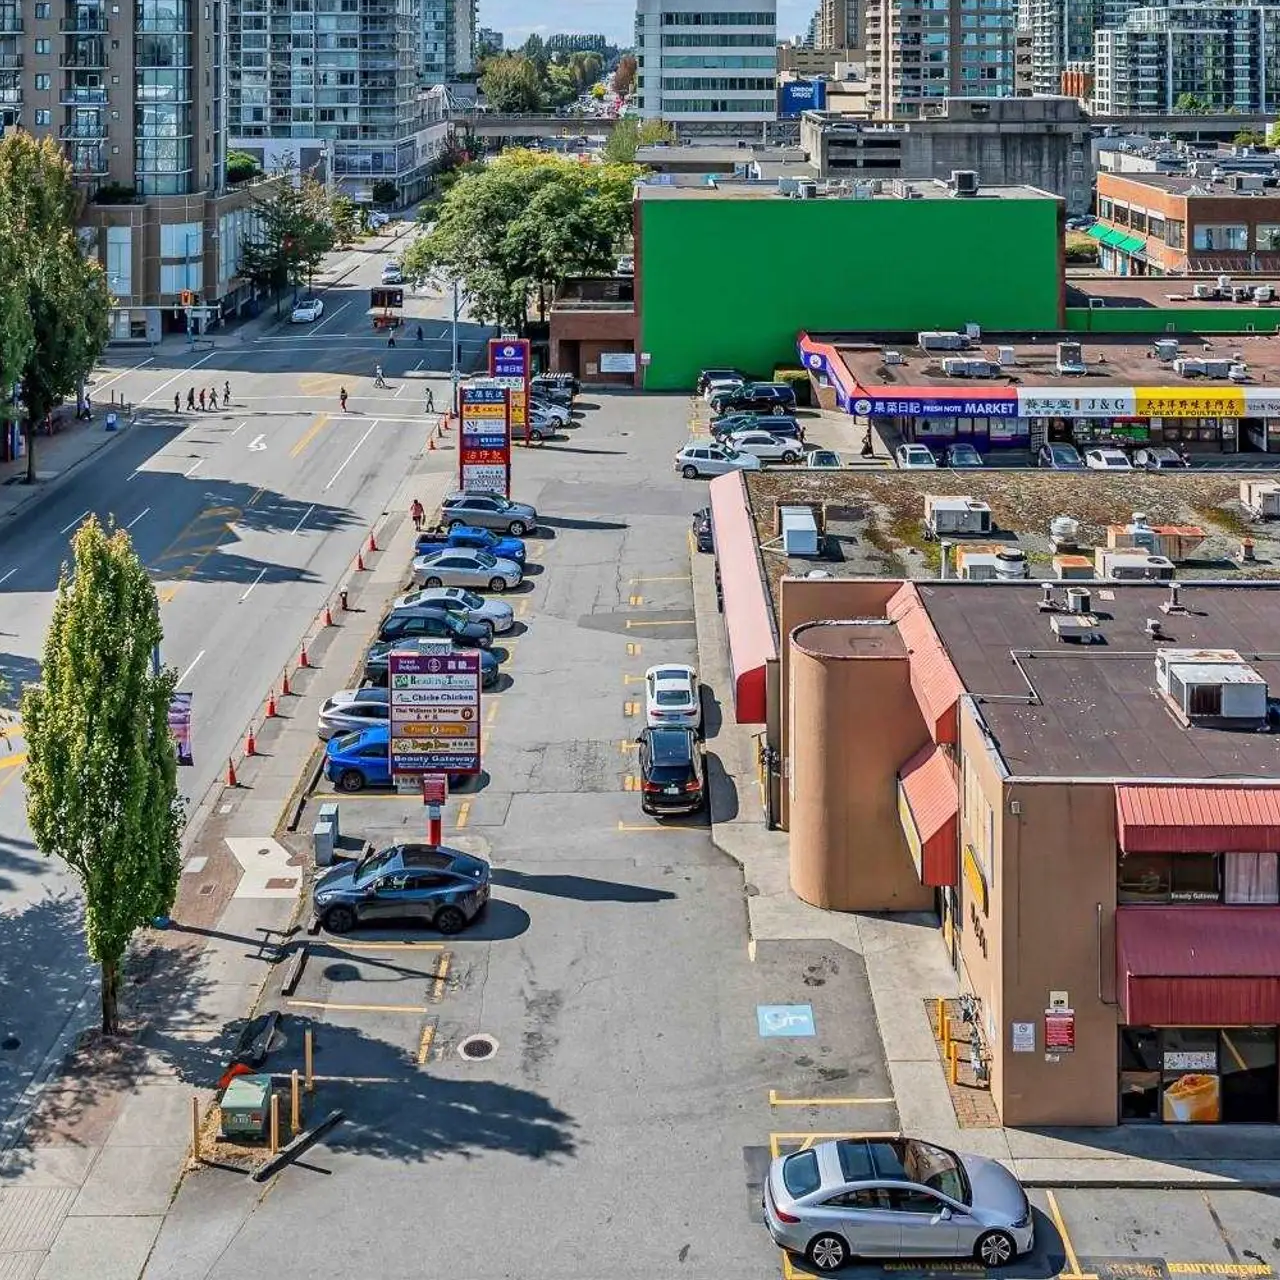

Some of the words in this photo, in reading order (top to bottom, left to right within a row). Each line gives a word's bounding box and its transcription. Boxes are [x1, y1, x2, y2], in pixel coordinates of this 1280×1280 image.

[964, 403, 1015, 414] MARKET
[1088, 399, 1095, 410] J
[1100, 400, 1110, 410] &
[1114, 399, 1125, 410] G
[440, 693, 474, 701] Chicken
